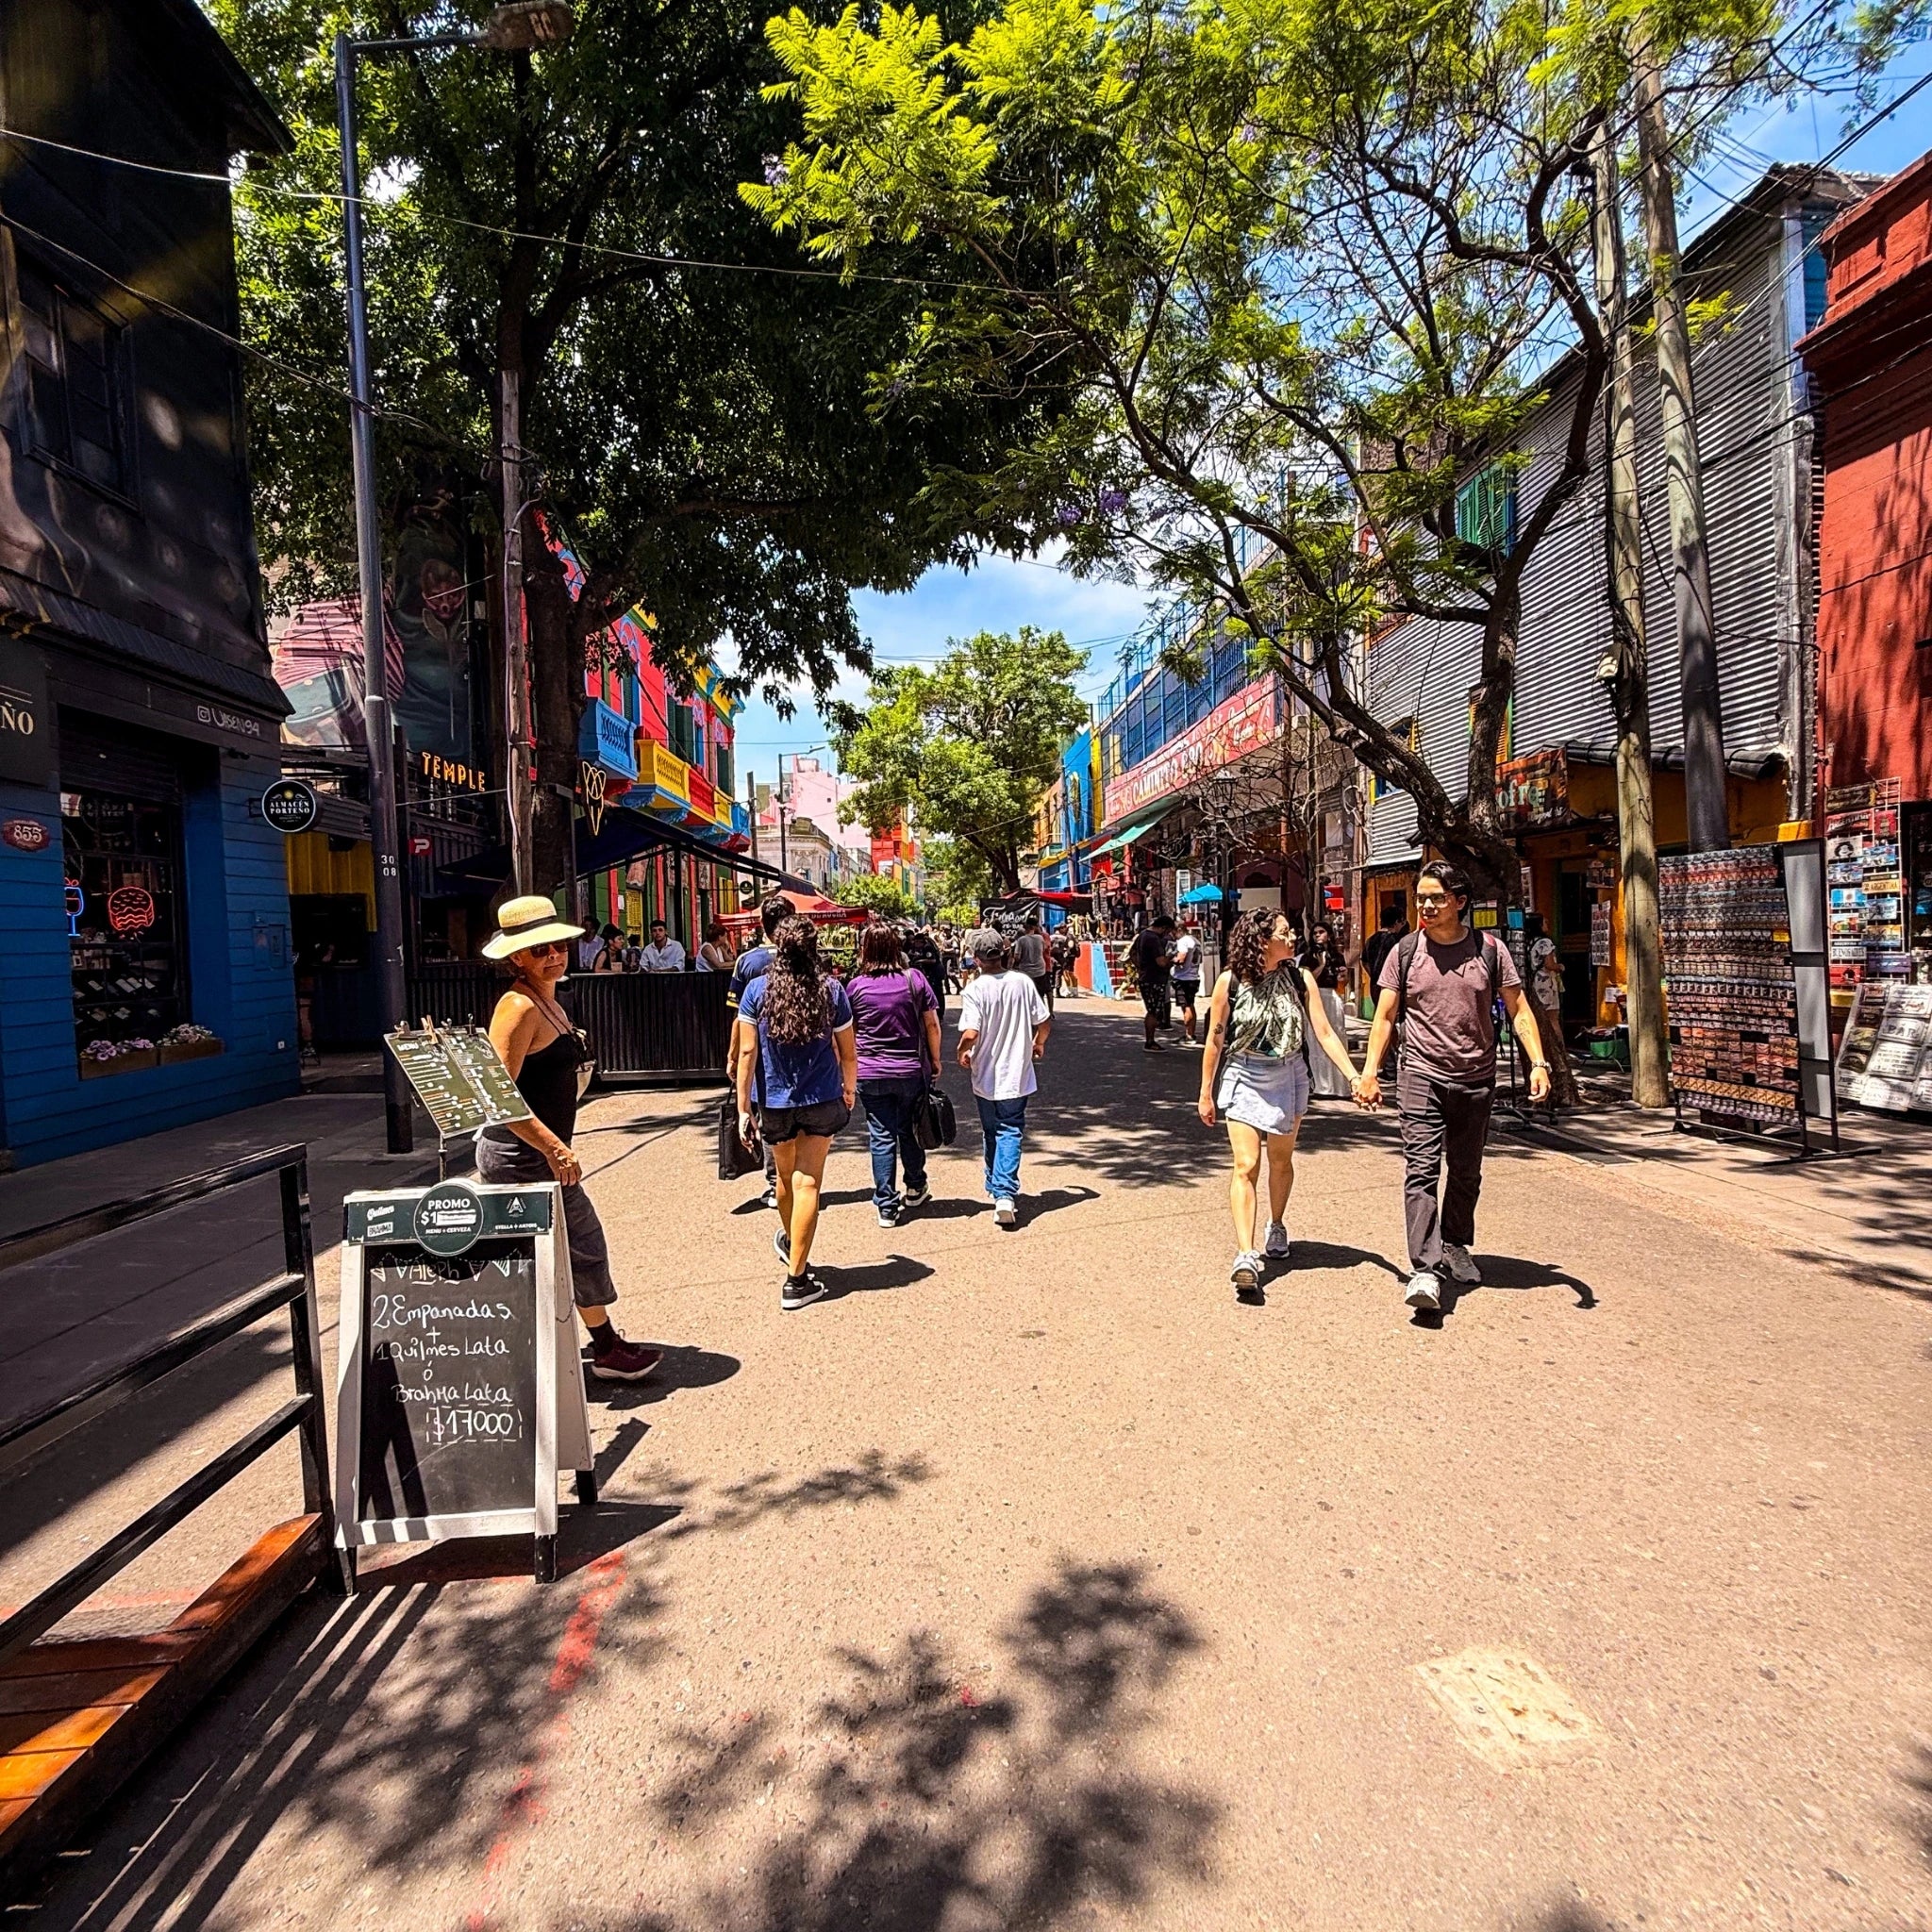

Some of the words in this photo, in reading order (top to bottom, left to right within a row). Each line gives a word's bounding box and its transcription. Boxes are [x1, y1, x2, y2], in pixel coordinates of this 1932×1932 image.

[422, 752, 486, 791] TEMPLE
[1498, 779, 1539, 808] ofre
[13, 824, 42, 843] 855
[381, 855, 394, 864] 30
[383, 868, 396, 876] 08
[428, 1198, 471, 1210] PROMO
[392, 1294, 512, 1328] Empanadas
[390, 1338, 460, 1362] Quilmes
[465, 1336, 509, 1355] Lata
[465, 1383, 512, 1404] Lata
